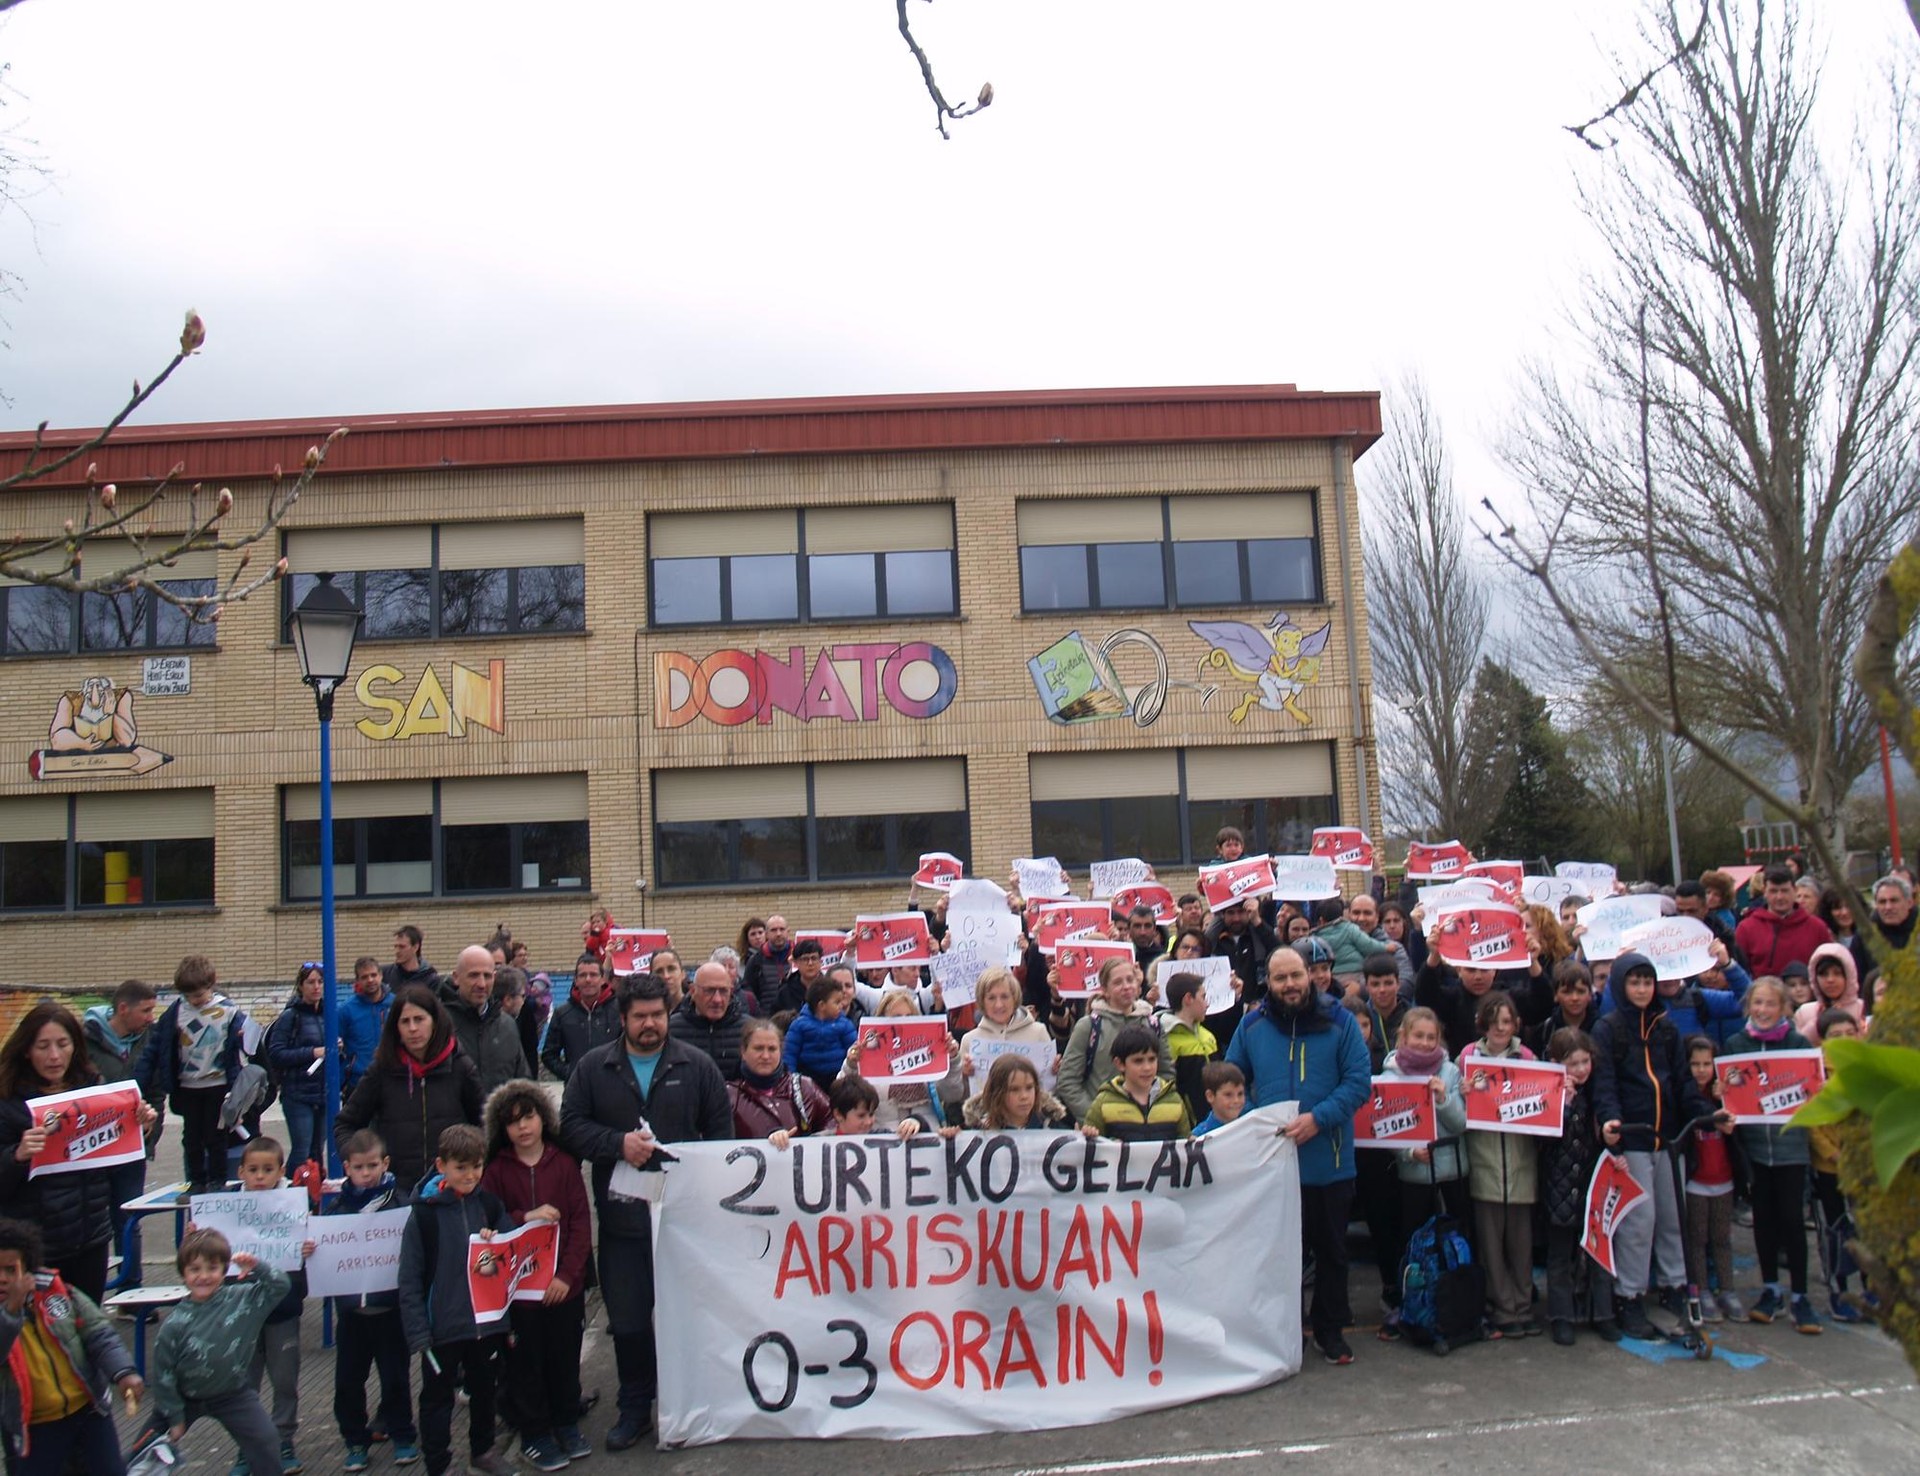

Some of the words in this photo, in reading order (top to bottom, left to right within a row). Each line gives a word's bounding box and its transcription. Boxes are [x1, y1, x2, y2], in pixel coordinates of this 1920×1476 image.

[354, 658, 505, 741] SAN
[652, 641, 958, 729] DONATO
[77, 1114, 87, 1129] 2
[720, 1145, 780, 1215] 2
[792, 1134, 1019, 1215] URTEKO
[1041, 1134, 1214, 1193] GELAK
[773, 1201, 1143, 1299] ARRISKUAN
[742, 1319, 877, 1413] 0-3
